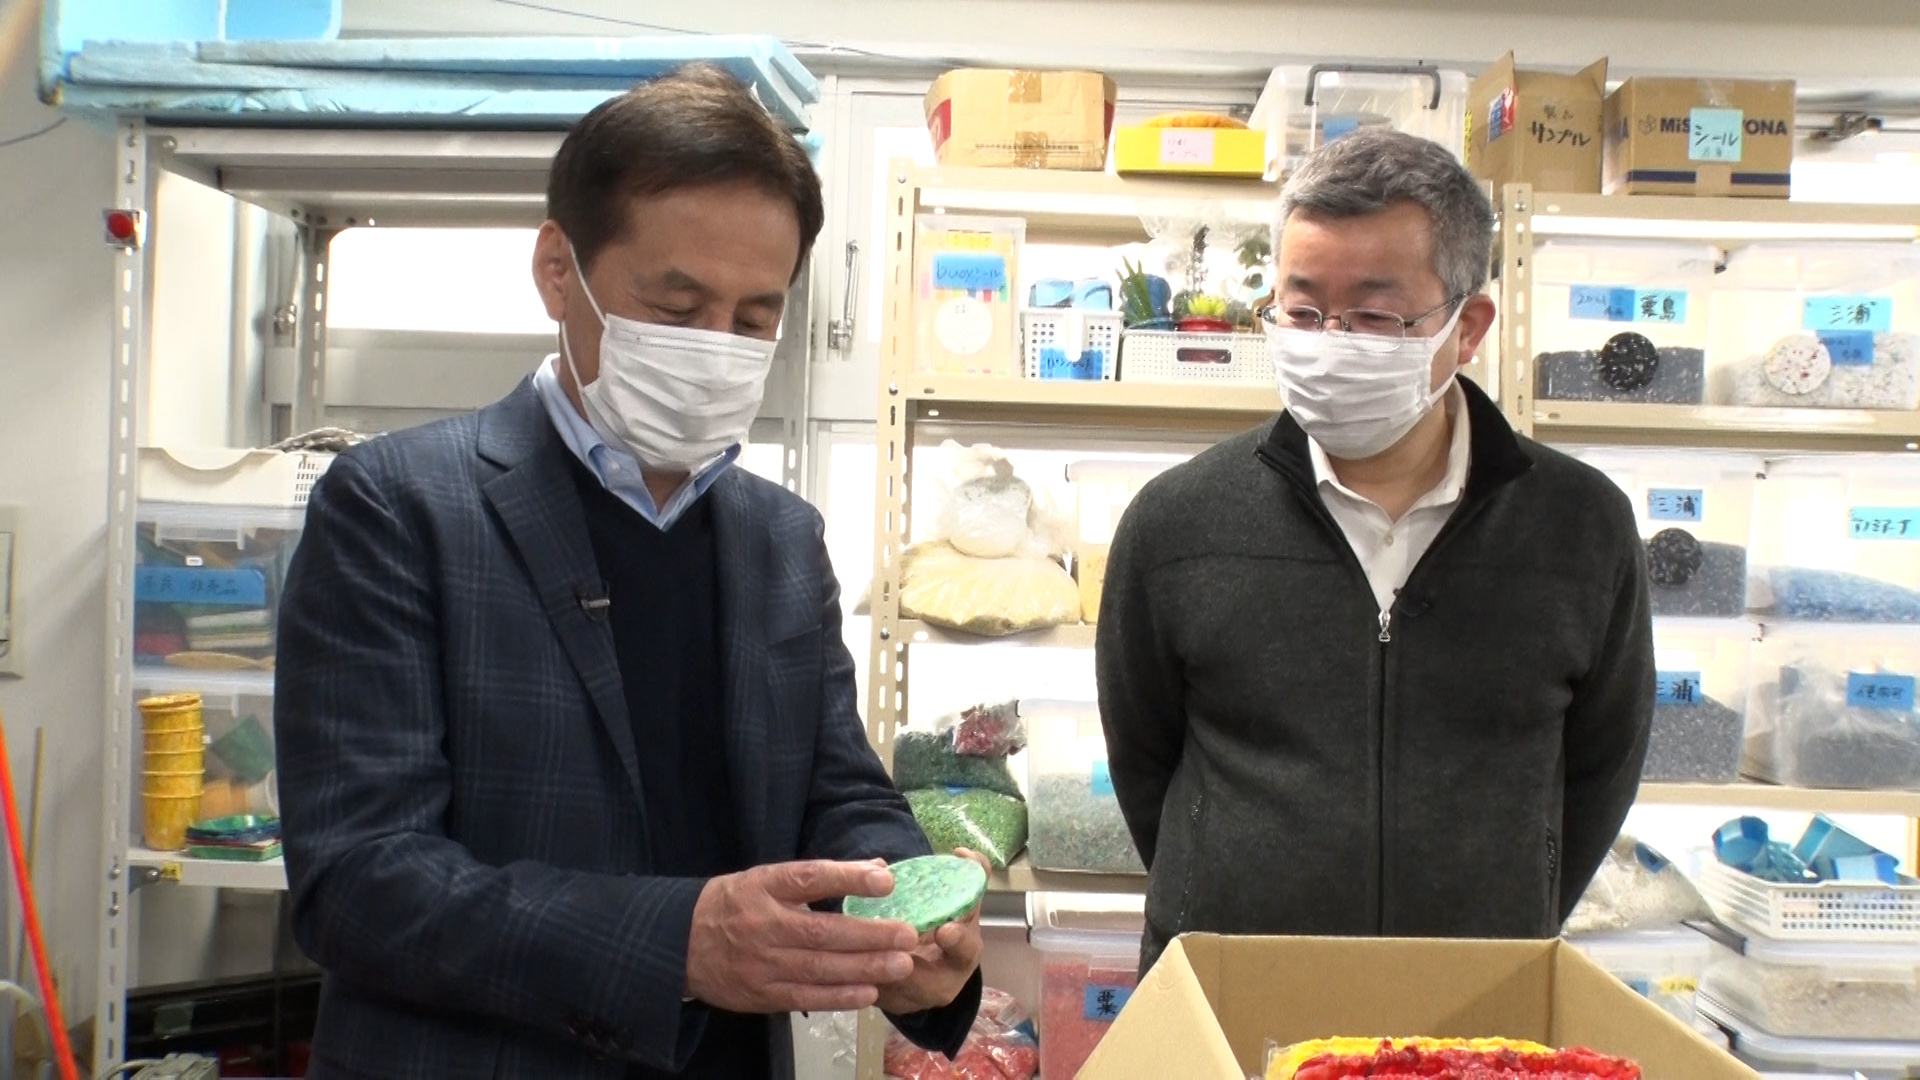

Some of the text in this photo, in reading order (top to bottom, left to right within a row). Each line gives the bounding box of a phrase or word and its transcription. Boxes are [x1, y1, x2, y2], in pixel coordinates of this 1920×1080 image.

[1528, 120, 1591, 146] サンプル
[1694, 123, 1739, 147] シール
[1828, 301, 1877, 325] 三浦
[1657, 495, 1699, 517] 三浦
[1656, 677, 1699, 701] 三浦
